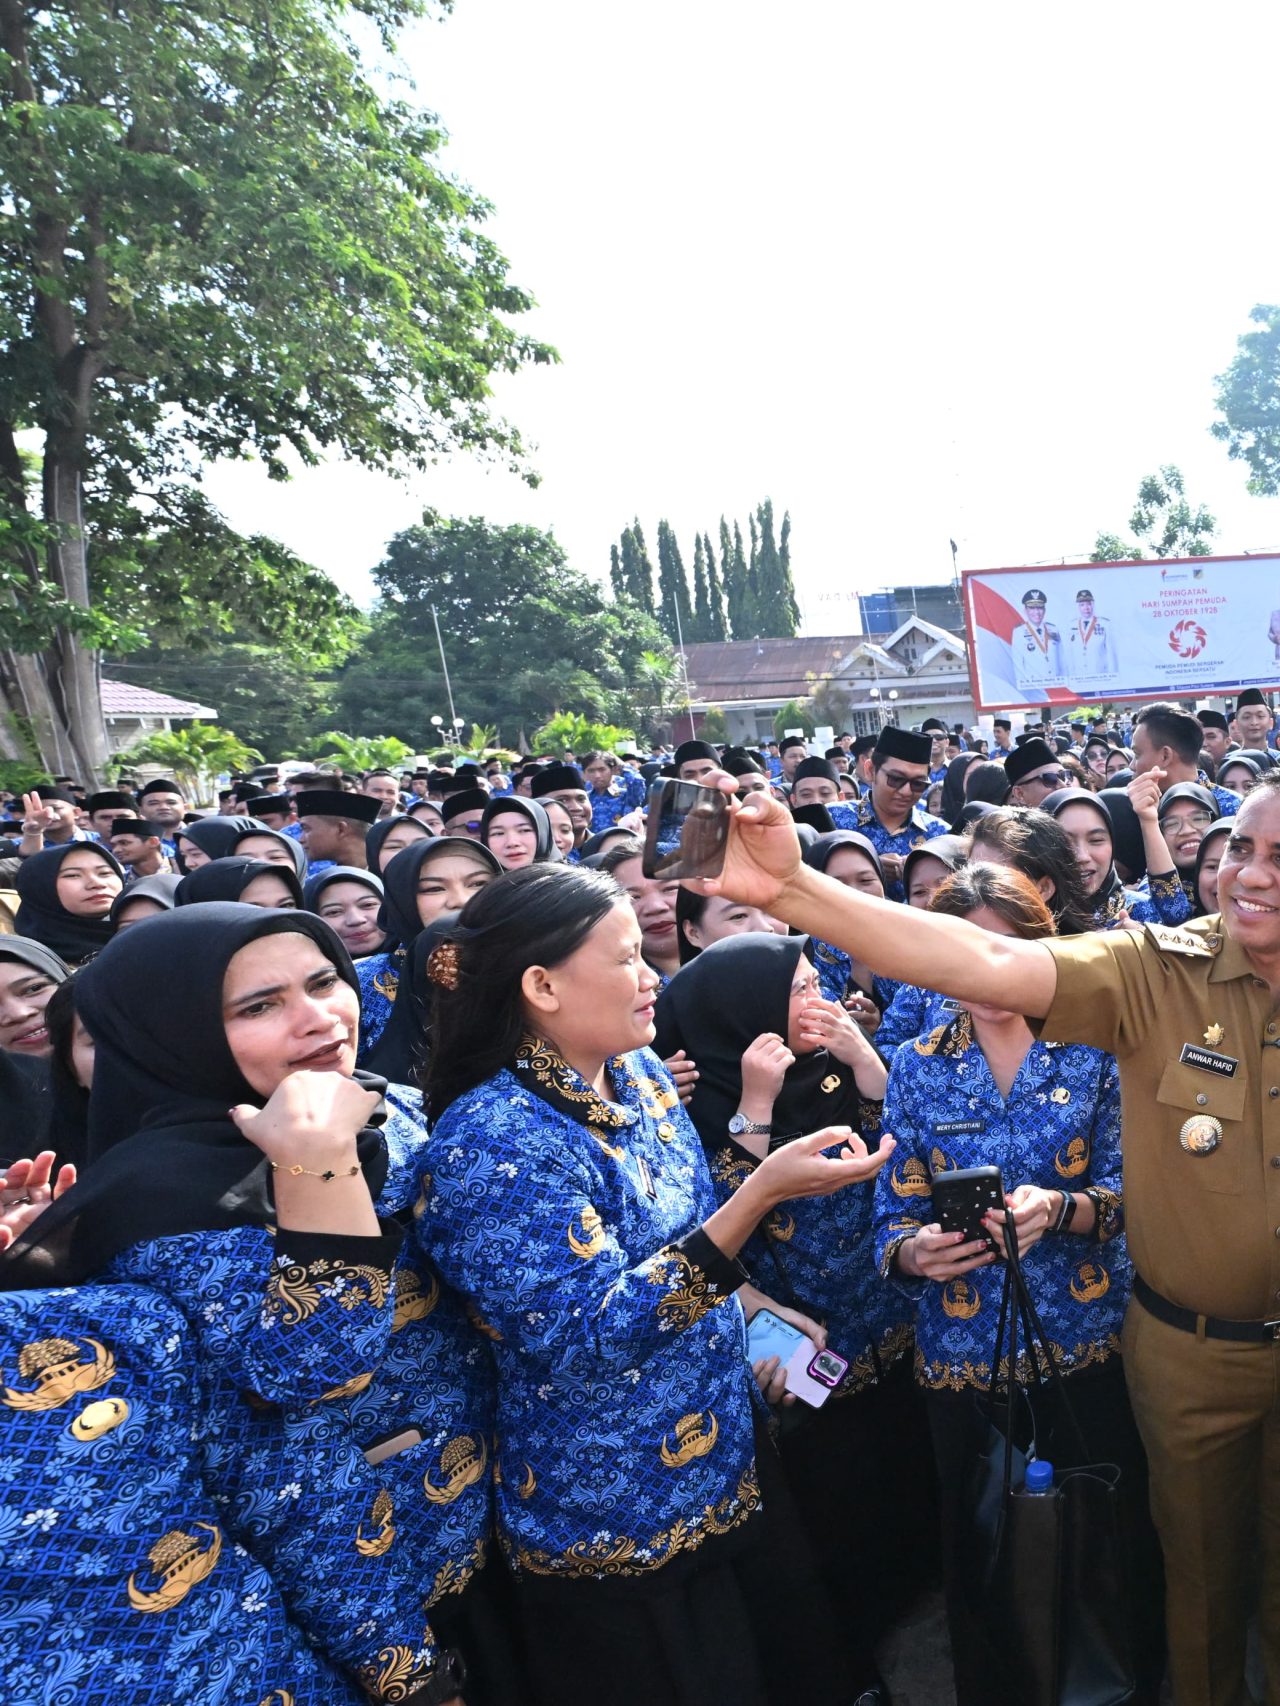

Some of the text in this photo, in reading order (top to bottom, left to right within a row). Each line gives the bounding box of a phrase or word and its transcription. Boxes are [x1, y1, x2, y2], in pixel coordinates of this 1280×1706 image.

[1160, 588, 1207, 597] PERINGATAN
[1162, 599, 1193, 607] SUMPAH
[1195, 596, 1226, 604] PEMUDA
[1164, 608, 1198, 616] OKTOBER
[1201, 606, 1218, 614] 1928
[1187, 1051, 1233, 1072] ANWAR HAFID
[951, 1122, 981, 1130] CHRISTIANI
